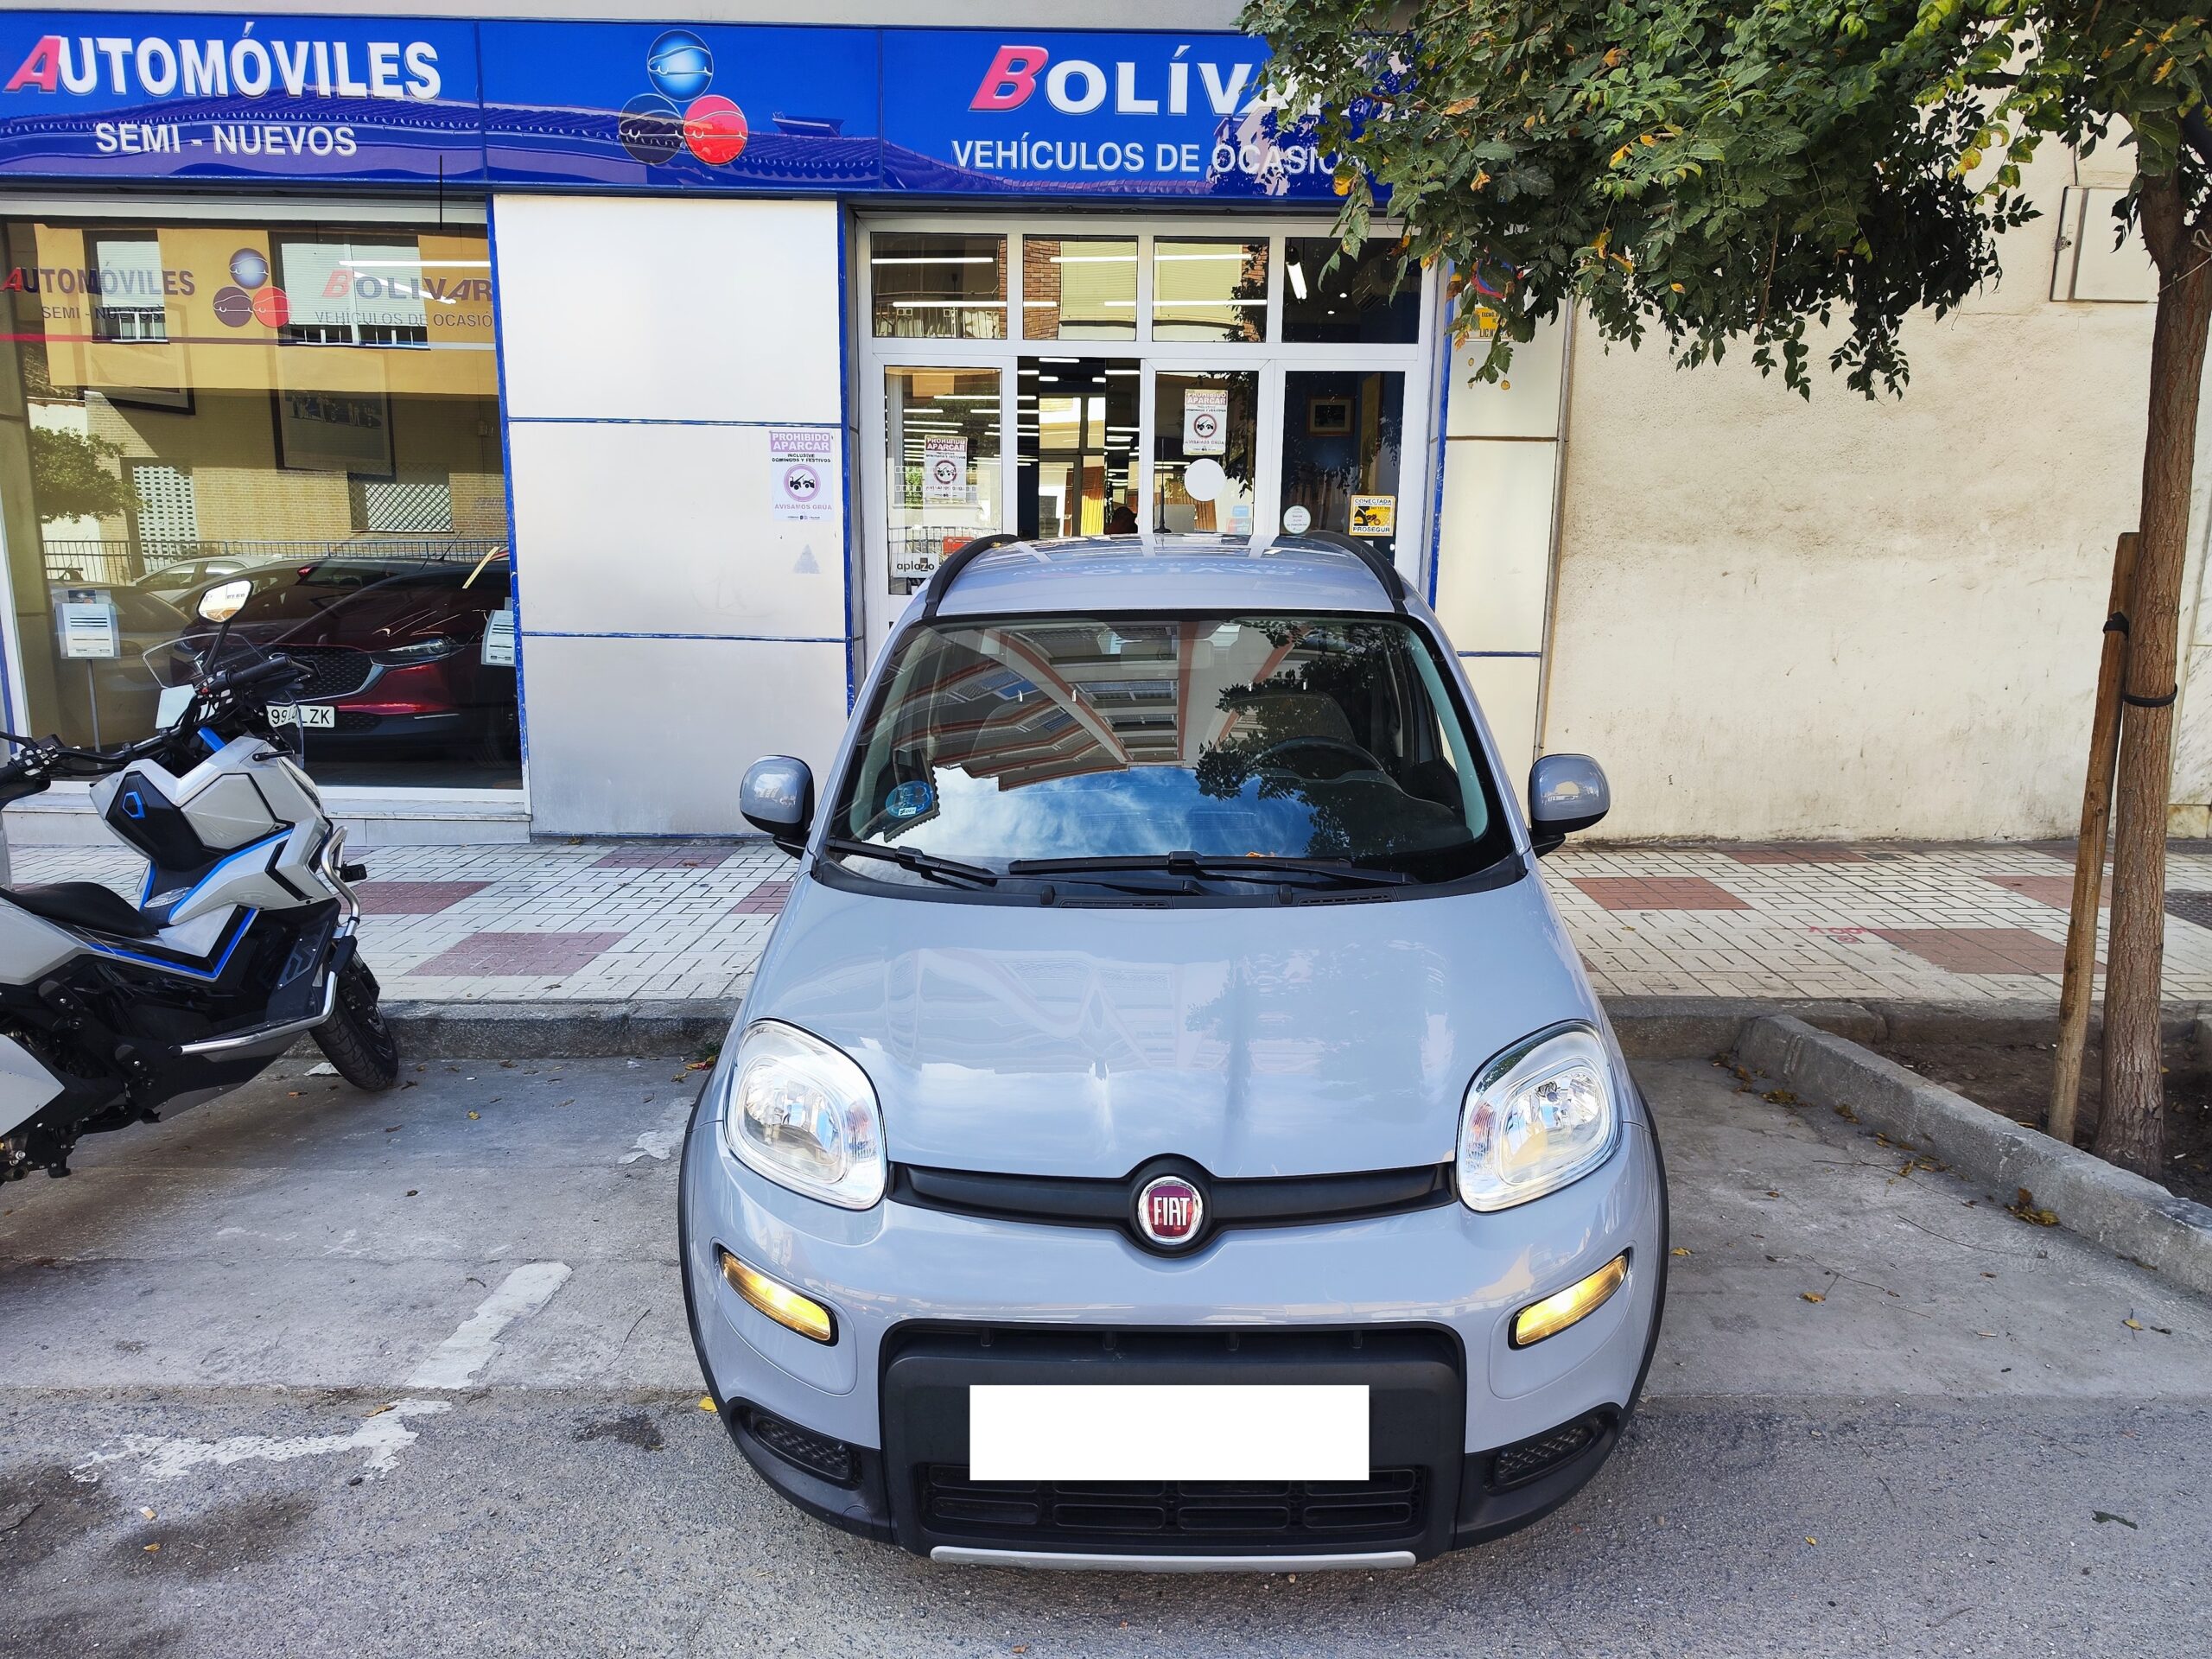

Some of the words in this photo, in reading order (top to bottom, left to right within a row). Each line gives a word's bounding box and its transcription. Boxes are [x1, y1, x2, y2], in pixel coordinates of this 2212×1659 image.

[3, 22, 442, 101] AUTOMÓVILES
[968, 44, 1374, 116] BOLÍVA
[95, 123, 181, 153] SEMI
[213, 124, 358, 157] NUEVOS
[951, 131, 1146, 172] VEHÍCULOS
[1156, 143, 1200, 173] DE
[1211, 144, 1367, 175] OCASI
[1, 261, 195, 296] AUTOMÓVILES
[41, 305, 80, 320] SEMI
[95, 306, 162, 321] NUEVOS
[315, 308, 403, 326] VEHÍCULOS
[408, 312, 429, 327] DE
[772, 433, 830, 442] PROHIBIDO
[772, 442, 830, 451] APARCAR
[927, 443, 966, 452] APARCAR
[897, 557, 935, 572] aplazo
[1154, 1197, 1190, 1225] FIAT
